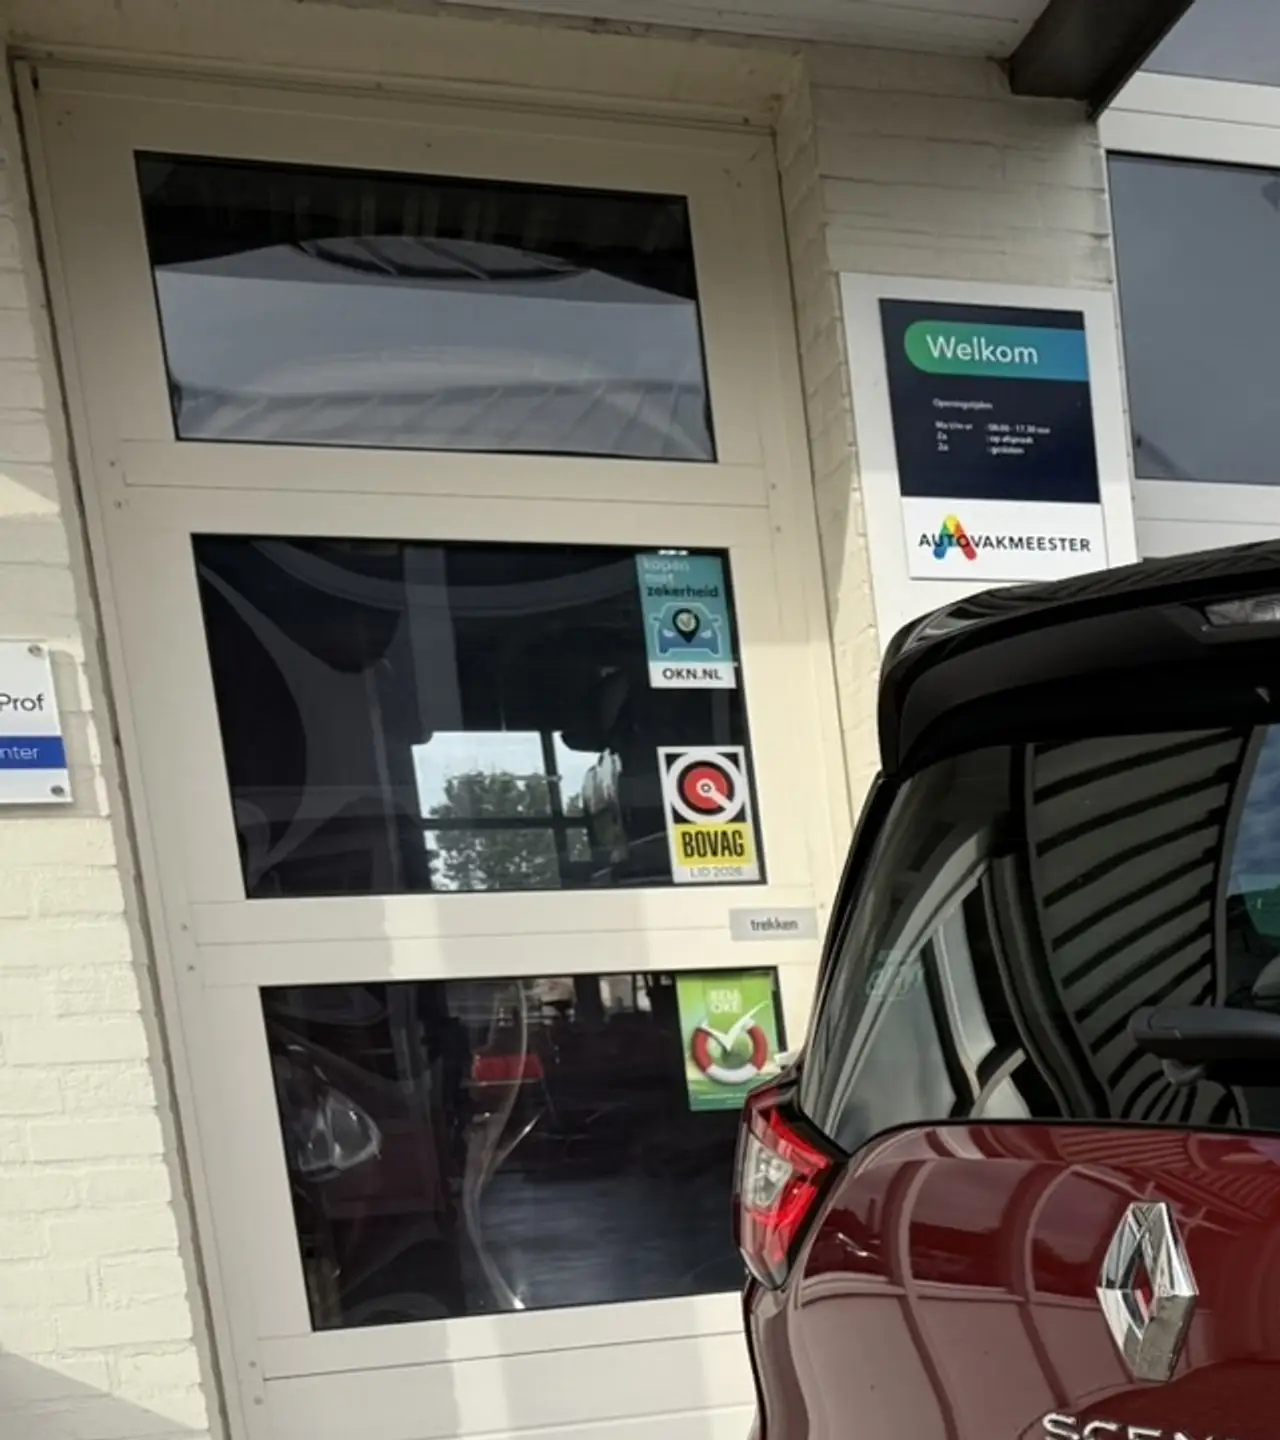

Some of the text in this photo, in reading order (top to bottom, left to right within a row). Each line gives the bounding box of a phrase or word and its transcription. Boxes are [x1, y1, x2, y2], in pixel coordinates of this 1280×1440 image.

[925, 334, 1039, 365] Welkom
[918, 533, 1091, 553] AUTOVAKMEESTER
[647, 584, 719, 598] zekerheid
[662, 667, 723, 681] OKN.NL
[681, 830, 746, 858] BOVAG
[750, 918, 799, 931] trekken
